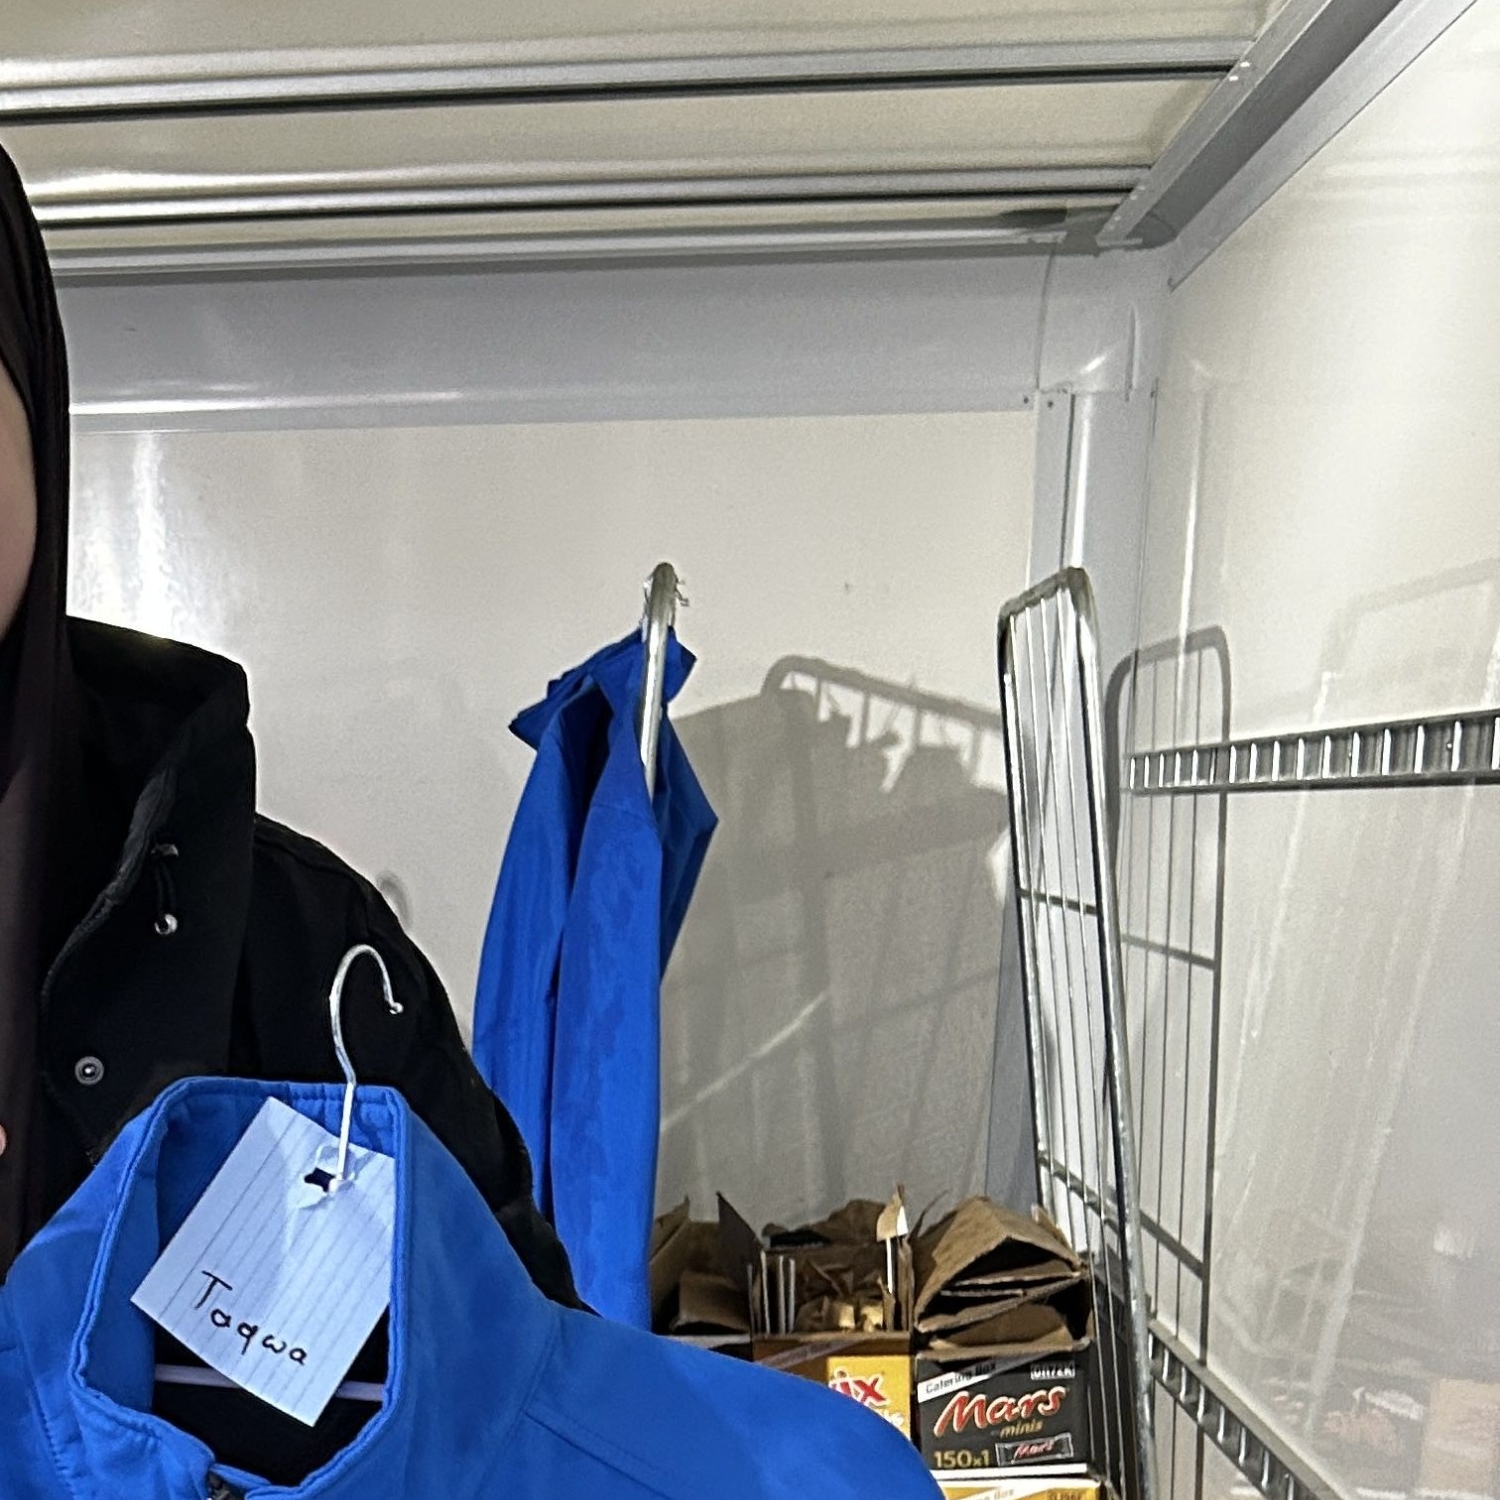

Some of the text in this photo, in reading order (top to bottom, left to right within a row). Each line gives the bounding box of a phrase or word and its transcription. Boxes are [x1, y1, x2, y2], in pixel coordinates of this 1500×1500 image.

[194, 1270, 308, 1367] Taqwa
[826, 1366, 888, 1406] ix
[925, 1372, 973, 1394] Catering
[933, 1385, 1067, 1438] Mars
[1001, 1419, 1044, 1438] minis
[933, 1450, 991, 1468] 150x1
[1012, 1440, 1056, 1463] Mars
